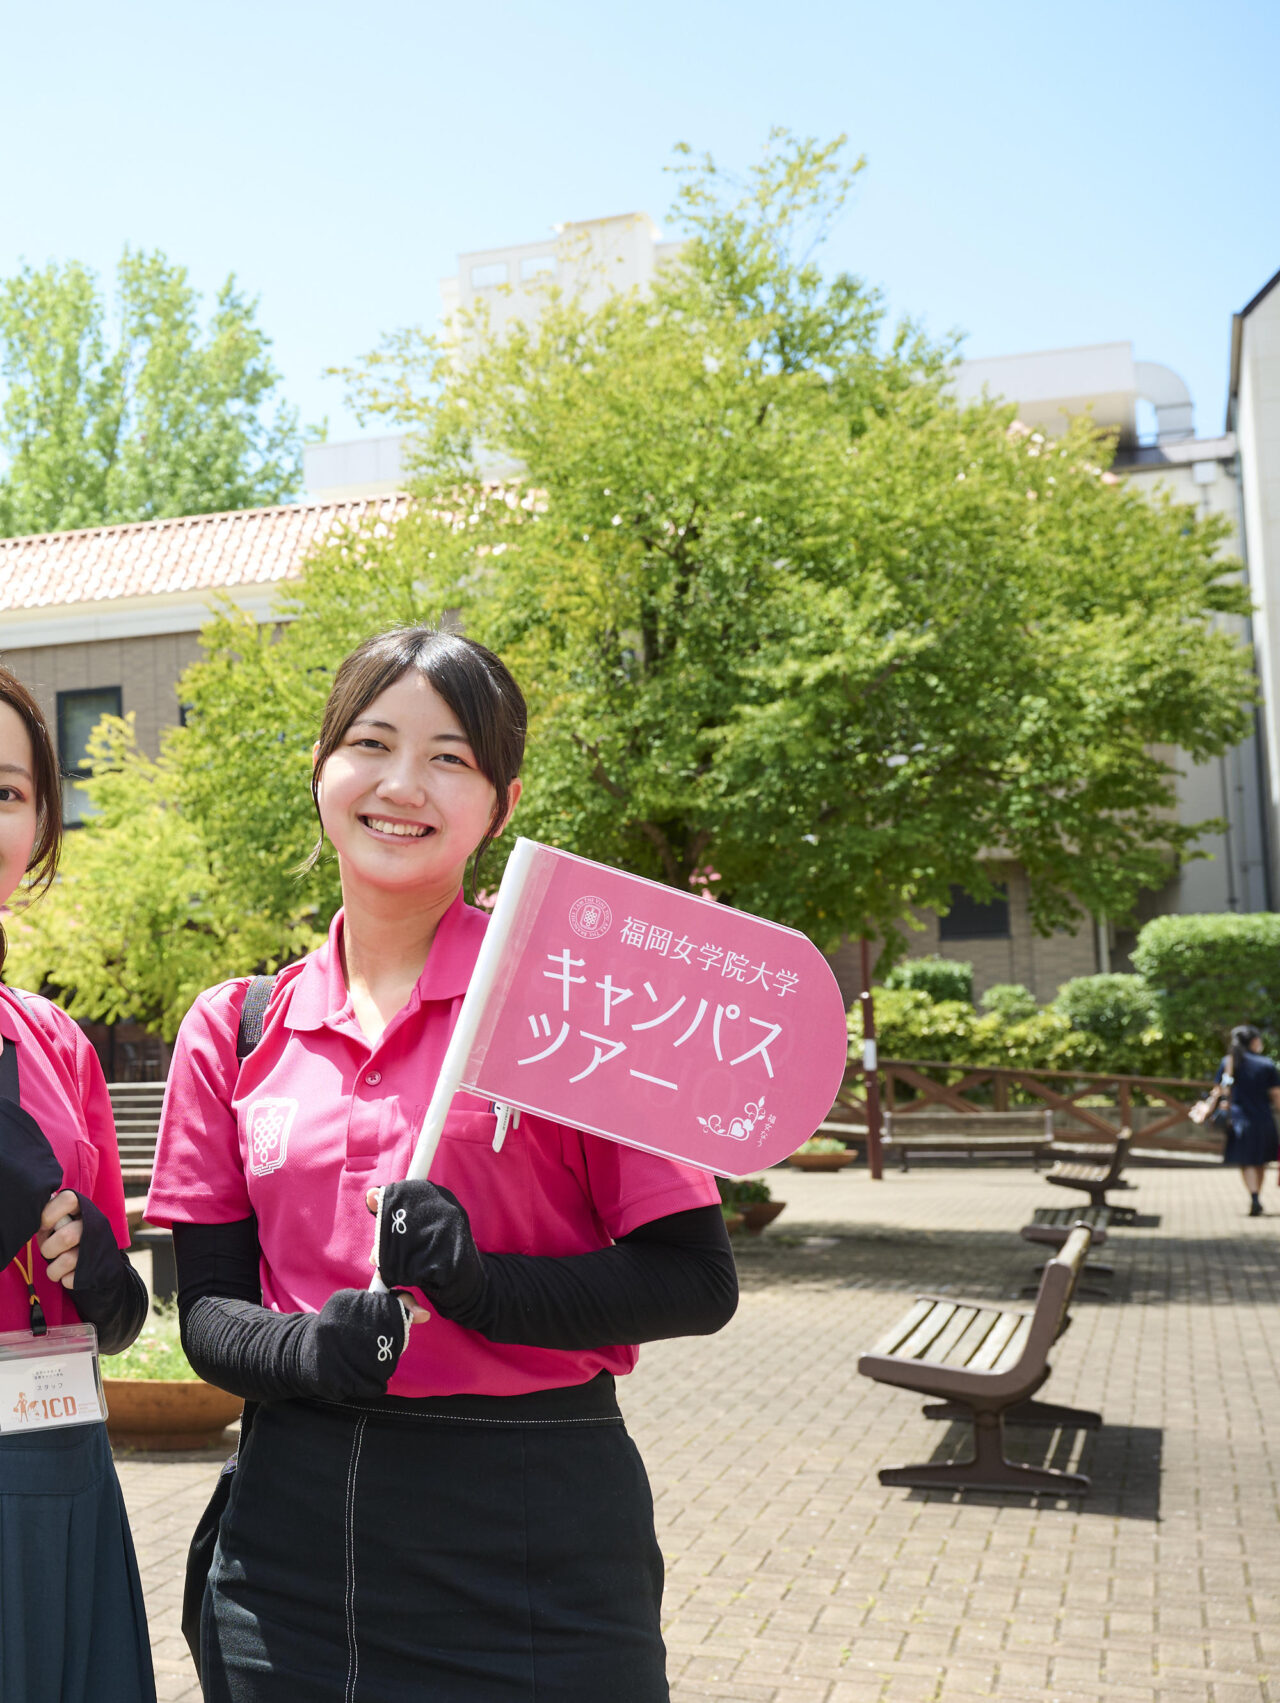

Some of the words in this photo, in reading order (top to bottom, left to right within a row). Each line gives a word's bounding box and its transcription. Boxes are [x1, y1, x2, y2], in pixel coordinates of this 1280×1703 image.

[619, 915, 801, 998] 福岡女学院大学
[517, 1013, 678, 1091] ツアー
[543, 948, 783, 1079] キャンパス
